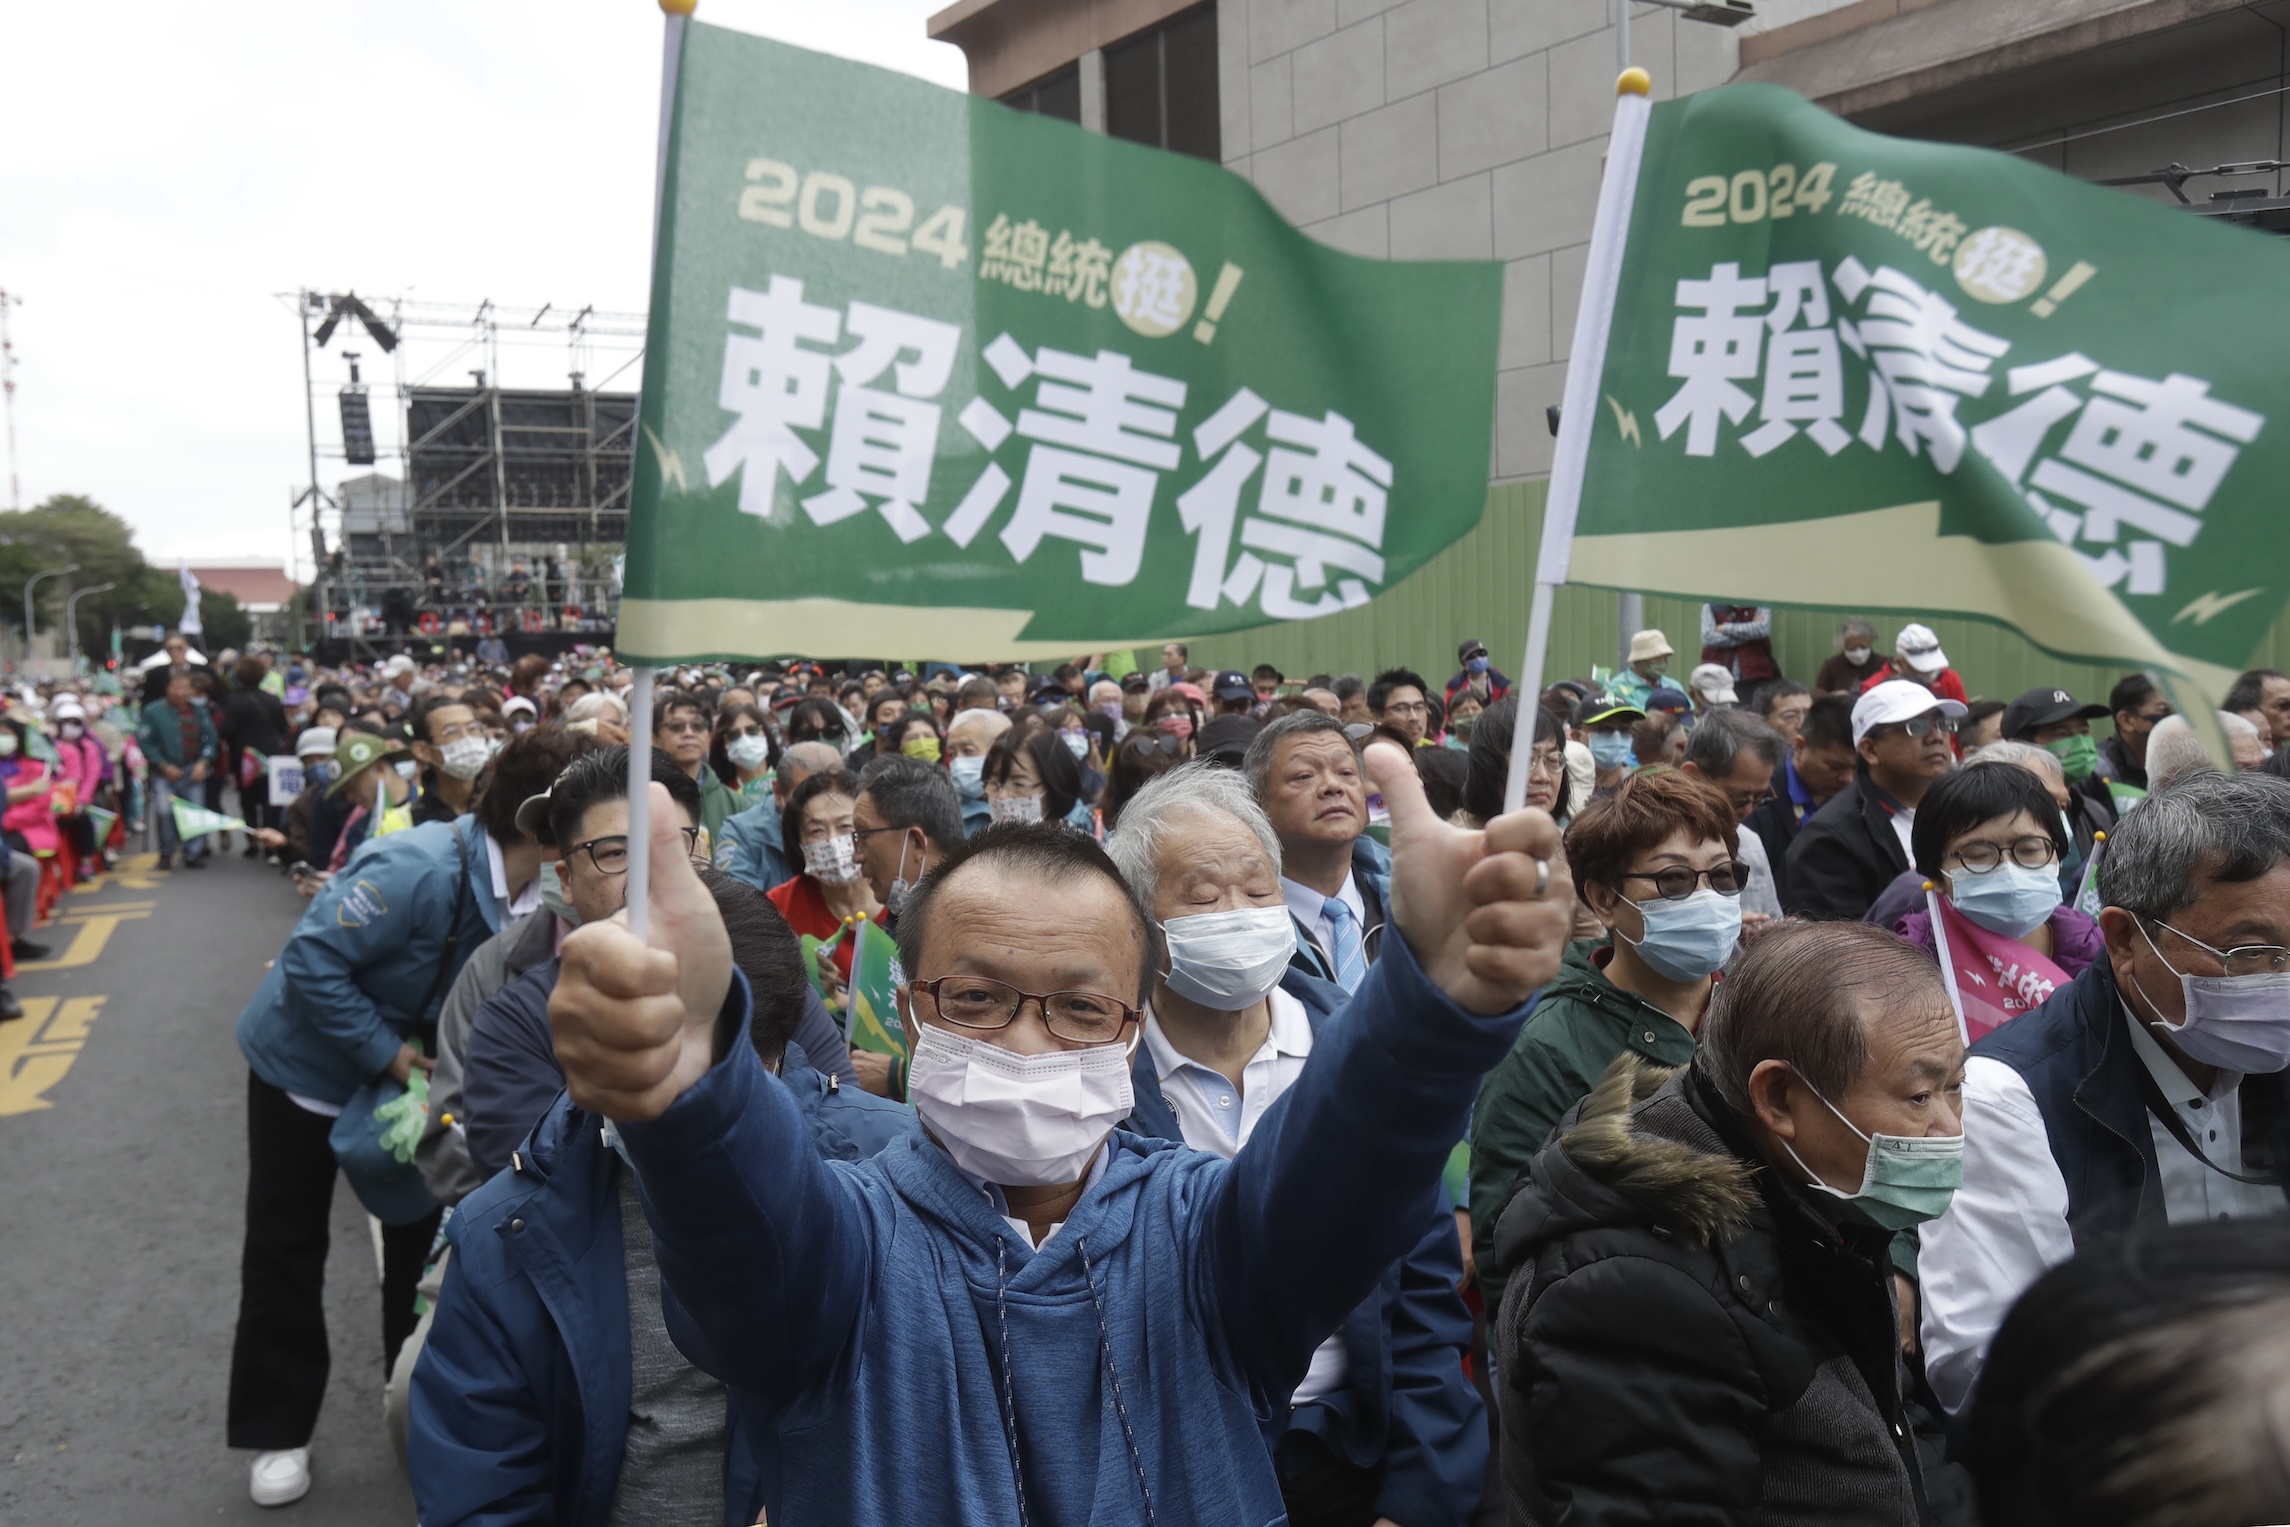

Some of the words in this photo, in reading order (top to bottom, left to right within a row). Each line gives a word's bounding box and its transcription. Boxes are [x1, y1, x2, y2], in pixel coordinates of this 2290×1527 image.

[738, 157, 969, 270] 2024
[1681, 162, 1838, 227] 2024
[702, 274, 1393, 620] 賴清德
[1653, 254, 2266, 594] 賴清德
[884, 1016, 904, 1031] 20
